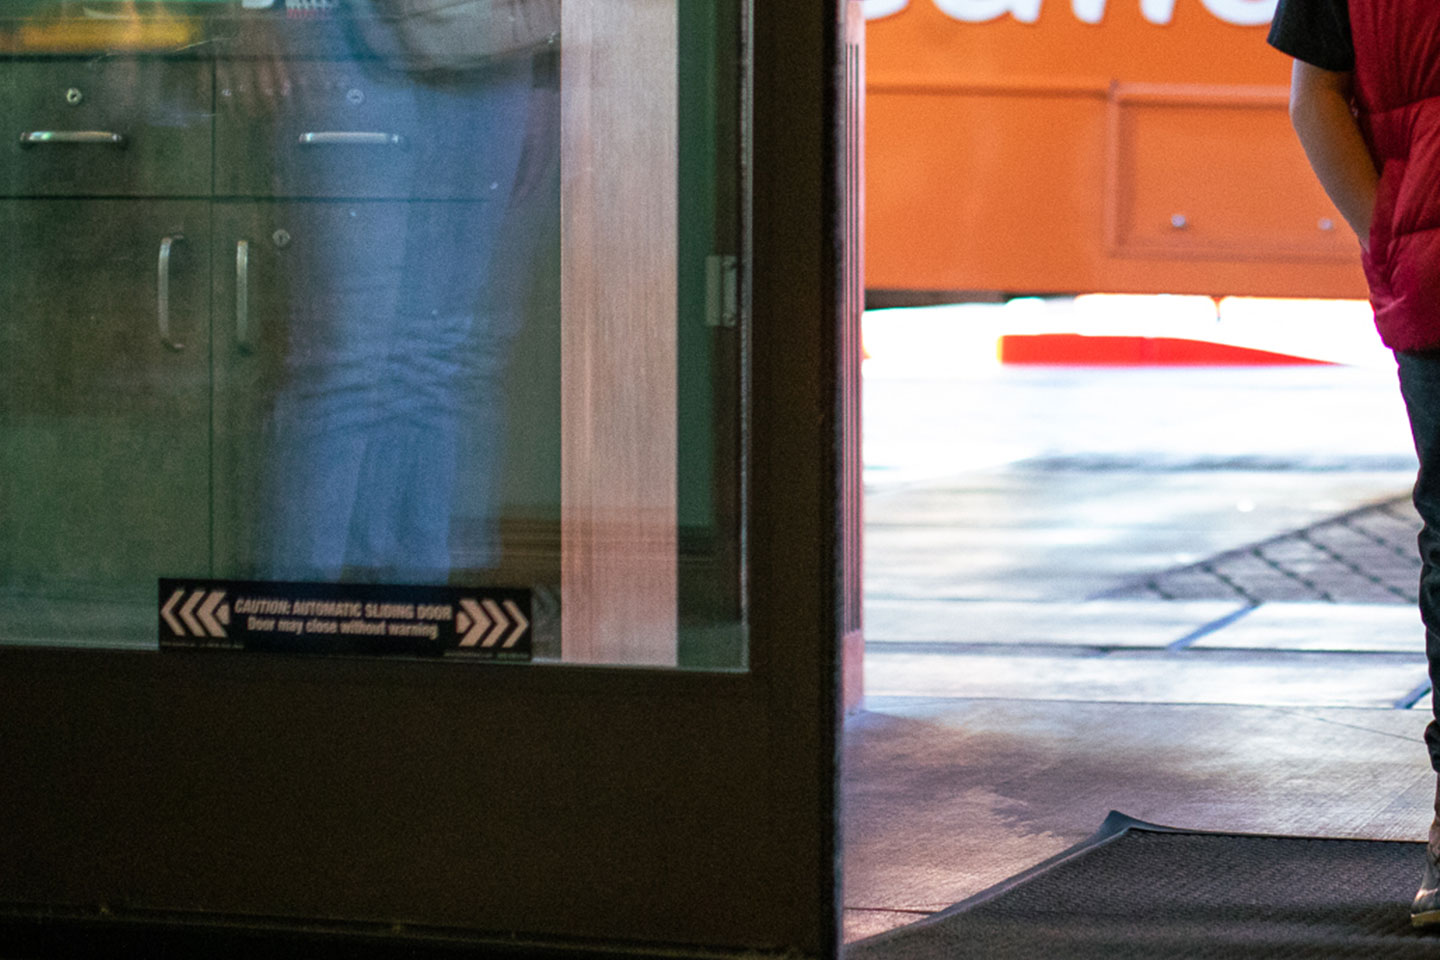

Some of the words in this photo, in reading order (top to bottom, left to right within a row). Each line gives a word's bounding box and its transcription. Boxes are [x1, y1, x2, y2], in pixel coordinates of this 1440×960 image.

[234, 598, 291, 615] CAUTION:
[292, 600, 363, 618] AUTOMATIC
[365, 602, 415, 619] SLIDING
[417, 603, 453, 620] DOOR
[247, 616, 276, 632] Door
[277, 619, 304, 636] may
[305, 618, 338, 634] close
[339, 618, 386, 636] without
[388, 622, 439, 641] warning
